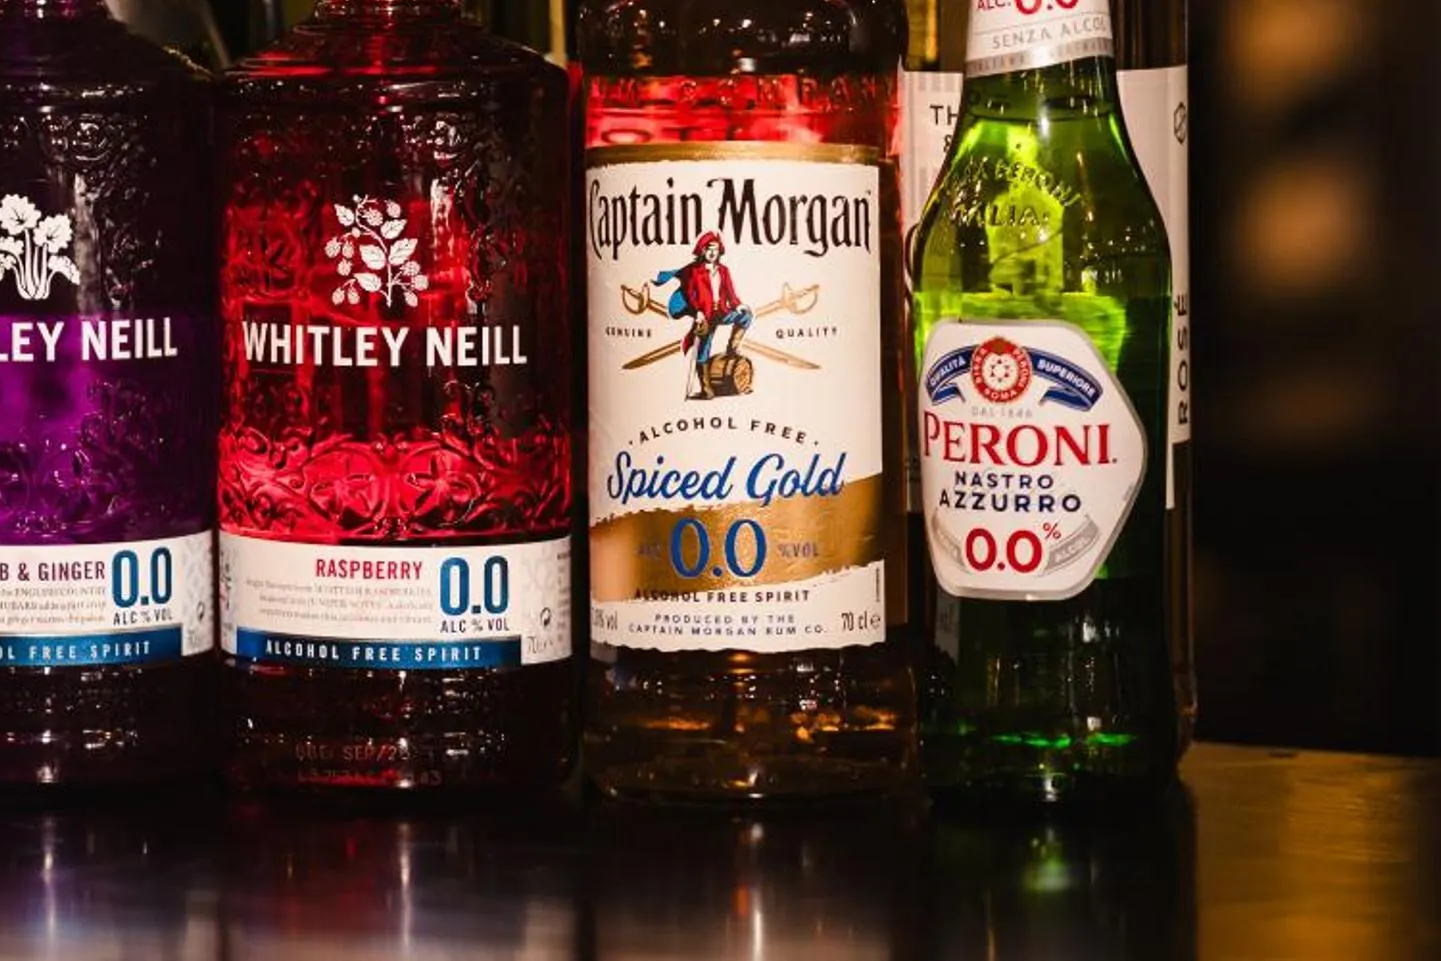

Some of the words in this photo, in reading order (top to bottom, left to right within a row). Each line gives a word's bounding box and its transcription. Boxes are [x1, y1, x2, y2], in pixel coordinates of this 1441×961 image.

[992, 28, 1051, 50] SENZA
[588, 177, 703, 261] Captain
[706, 177, 871, 258] Morgan
[81, 317, 178, 361] NEILL
[241, 321, 409, 367] WHITLEY
[426, 325, 528, 367] NEILL
[776, 326, 839, 340] QUALITY
[1037, 359, 1096, 398] SUPERIORE
[984, 388, 1018, 401] ROMA
[638, 416, 738, 445] ALCOHOL
[750, 420, 807, 444] FREE
[923, 410, 1112, 466] PERONI
[607, 450, 738, 505] Spiced
[745, 451, 847, 509] Gold
[954, 471, 1054, 490] NASTRO
[939, 489, 1082, 513] AZZURRO
[670, 517, 768, 578] 0.0
[965, 522, 1062, 573] 0.0%
[17, 563, 30, 581] &
[38, 561, 106, 581] GINGER
[111, 547, 172, 608] 0.0
[316, 559, 423, 580] RASPBERRY
[440, 556, 508, 615] 0.0
[634, 589, 700, 603] ALCOHOL
[707, 592, 748, 602] FREE
[755, 590, 810, 602] SPIRIT
[113, 613, 137, 626] ALC
[154, 609, 173, 622] VOL
[440, 620, 466, 633] ALC
[471, 619, 483, 632] %
[488, 619, 509, 631] VOL
[655, 614, 732, 624] PRODUCED
[741, 614, 758, 624] BY
[768, 614, 795, 624] THE
[841, 611, 854, 630] 70
[629, 624, 682, 635] CAPTAIN
[691, 626, 756, 636] MORGAN
[766, 626, 796, 635] RUM
[804, 625, 827, 635] CO.
[29, 645, 76, 660] FREE
[90, 641, 150, 659] SPIRIT
[265, 639, 339, 659] ALCOHOL
[352, 647, 400, 661] FREE
[415, 646, 481, 660] SPIRIT
